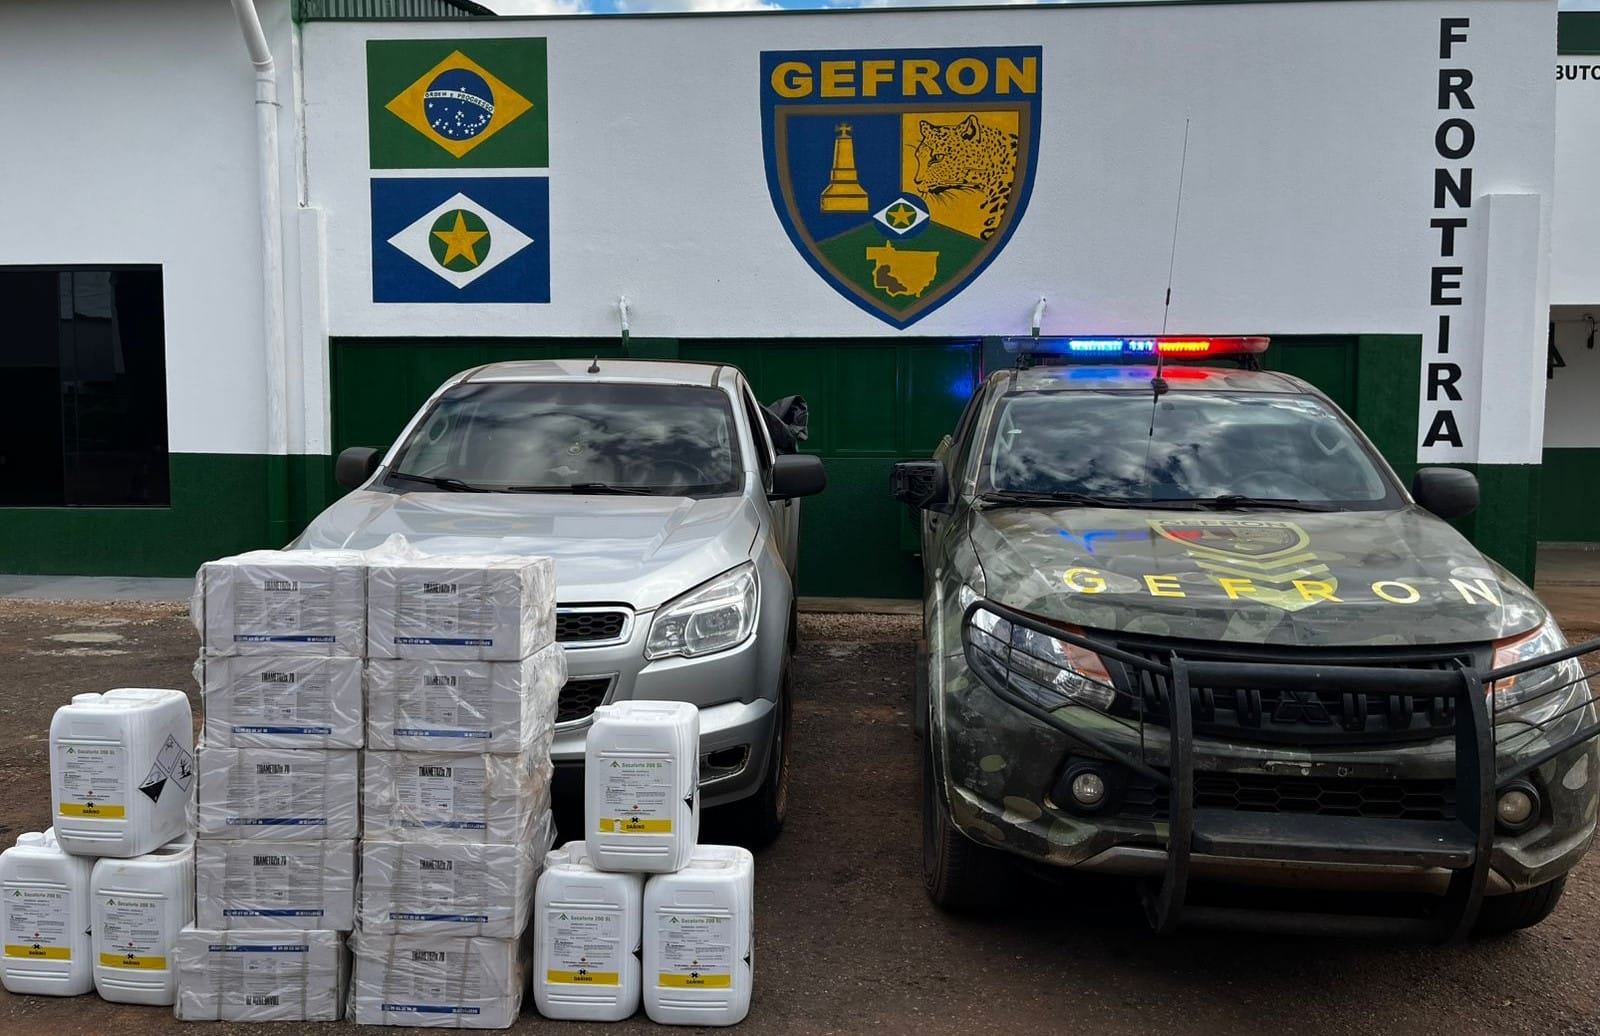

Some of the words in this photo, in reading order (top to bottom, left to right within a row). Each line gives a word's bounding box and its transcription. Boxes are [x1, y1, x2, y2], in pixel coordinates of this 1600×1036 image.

[770, 56, 1037, 98] GEFRON
[457, 93, 493, 112] PROGRESSO
[1422, 17, 1476, 448] FRONTEIRA
[1062, 567, 1503, 607] GEFRON
